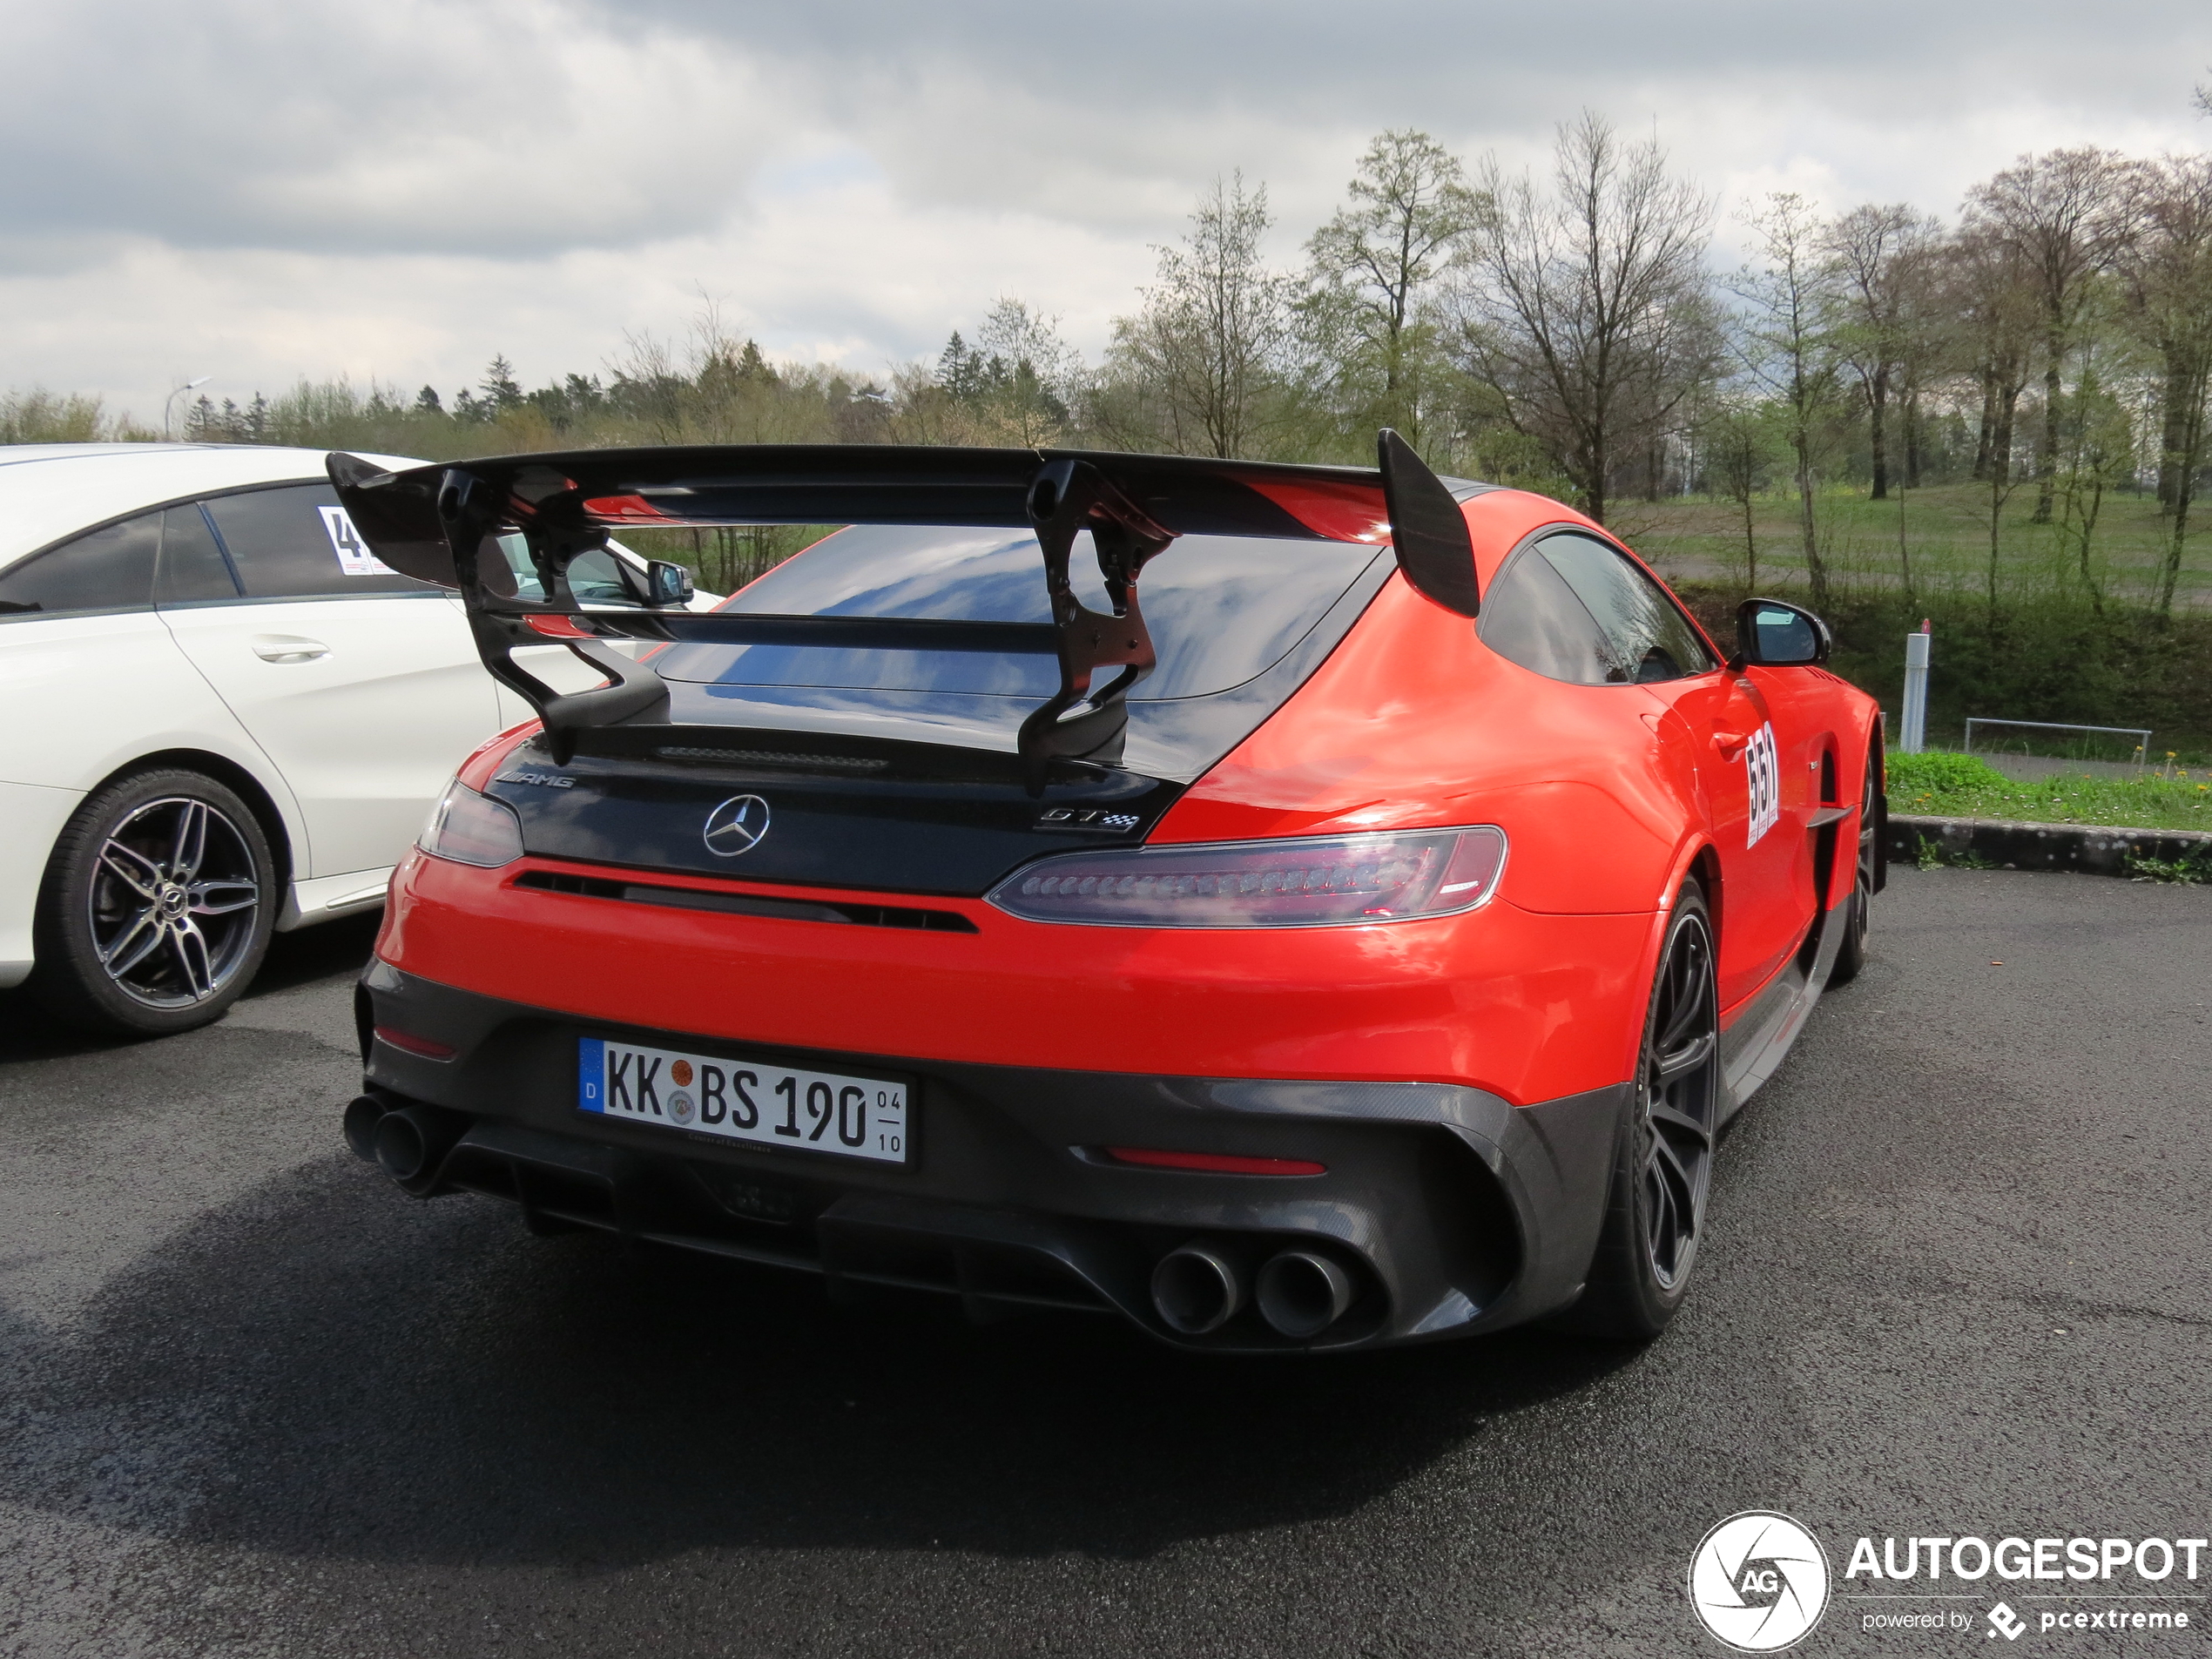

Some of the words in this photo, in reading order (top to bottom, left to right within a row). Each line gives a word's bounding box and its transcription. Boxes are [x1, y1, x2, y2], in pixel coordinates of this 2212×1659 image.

[331, 513, 374, 558] 4
[516, 772, 577, 788] AMG
[1747, 732, 1776, 822] 551
[1040, 807, 1109, 821] GT
[585, 1082, 597, 1099] D
[608, 1049, 662, 1116] KK
[701, 1063, 759, 1130] BS
[774, 1076, 867, 1147] 190
[877, 1090, 900, 1110] 04
[879, 1133, 900, 1153] 10
